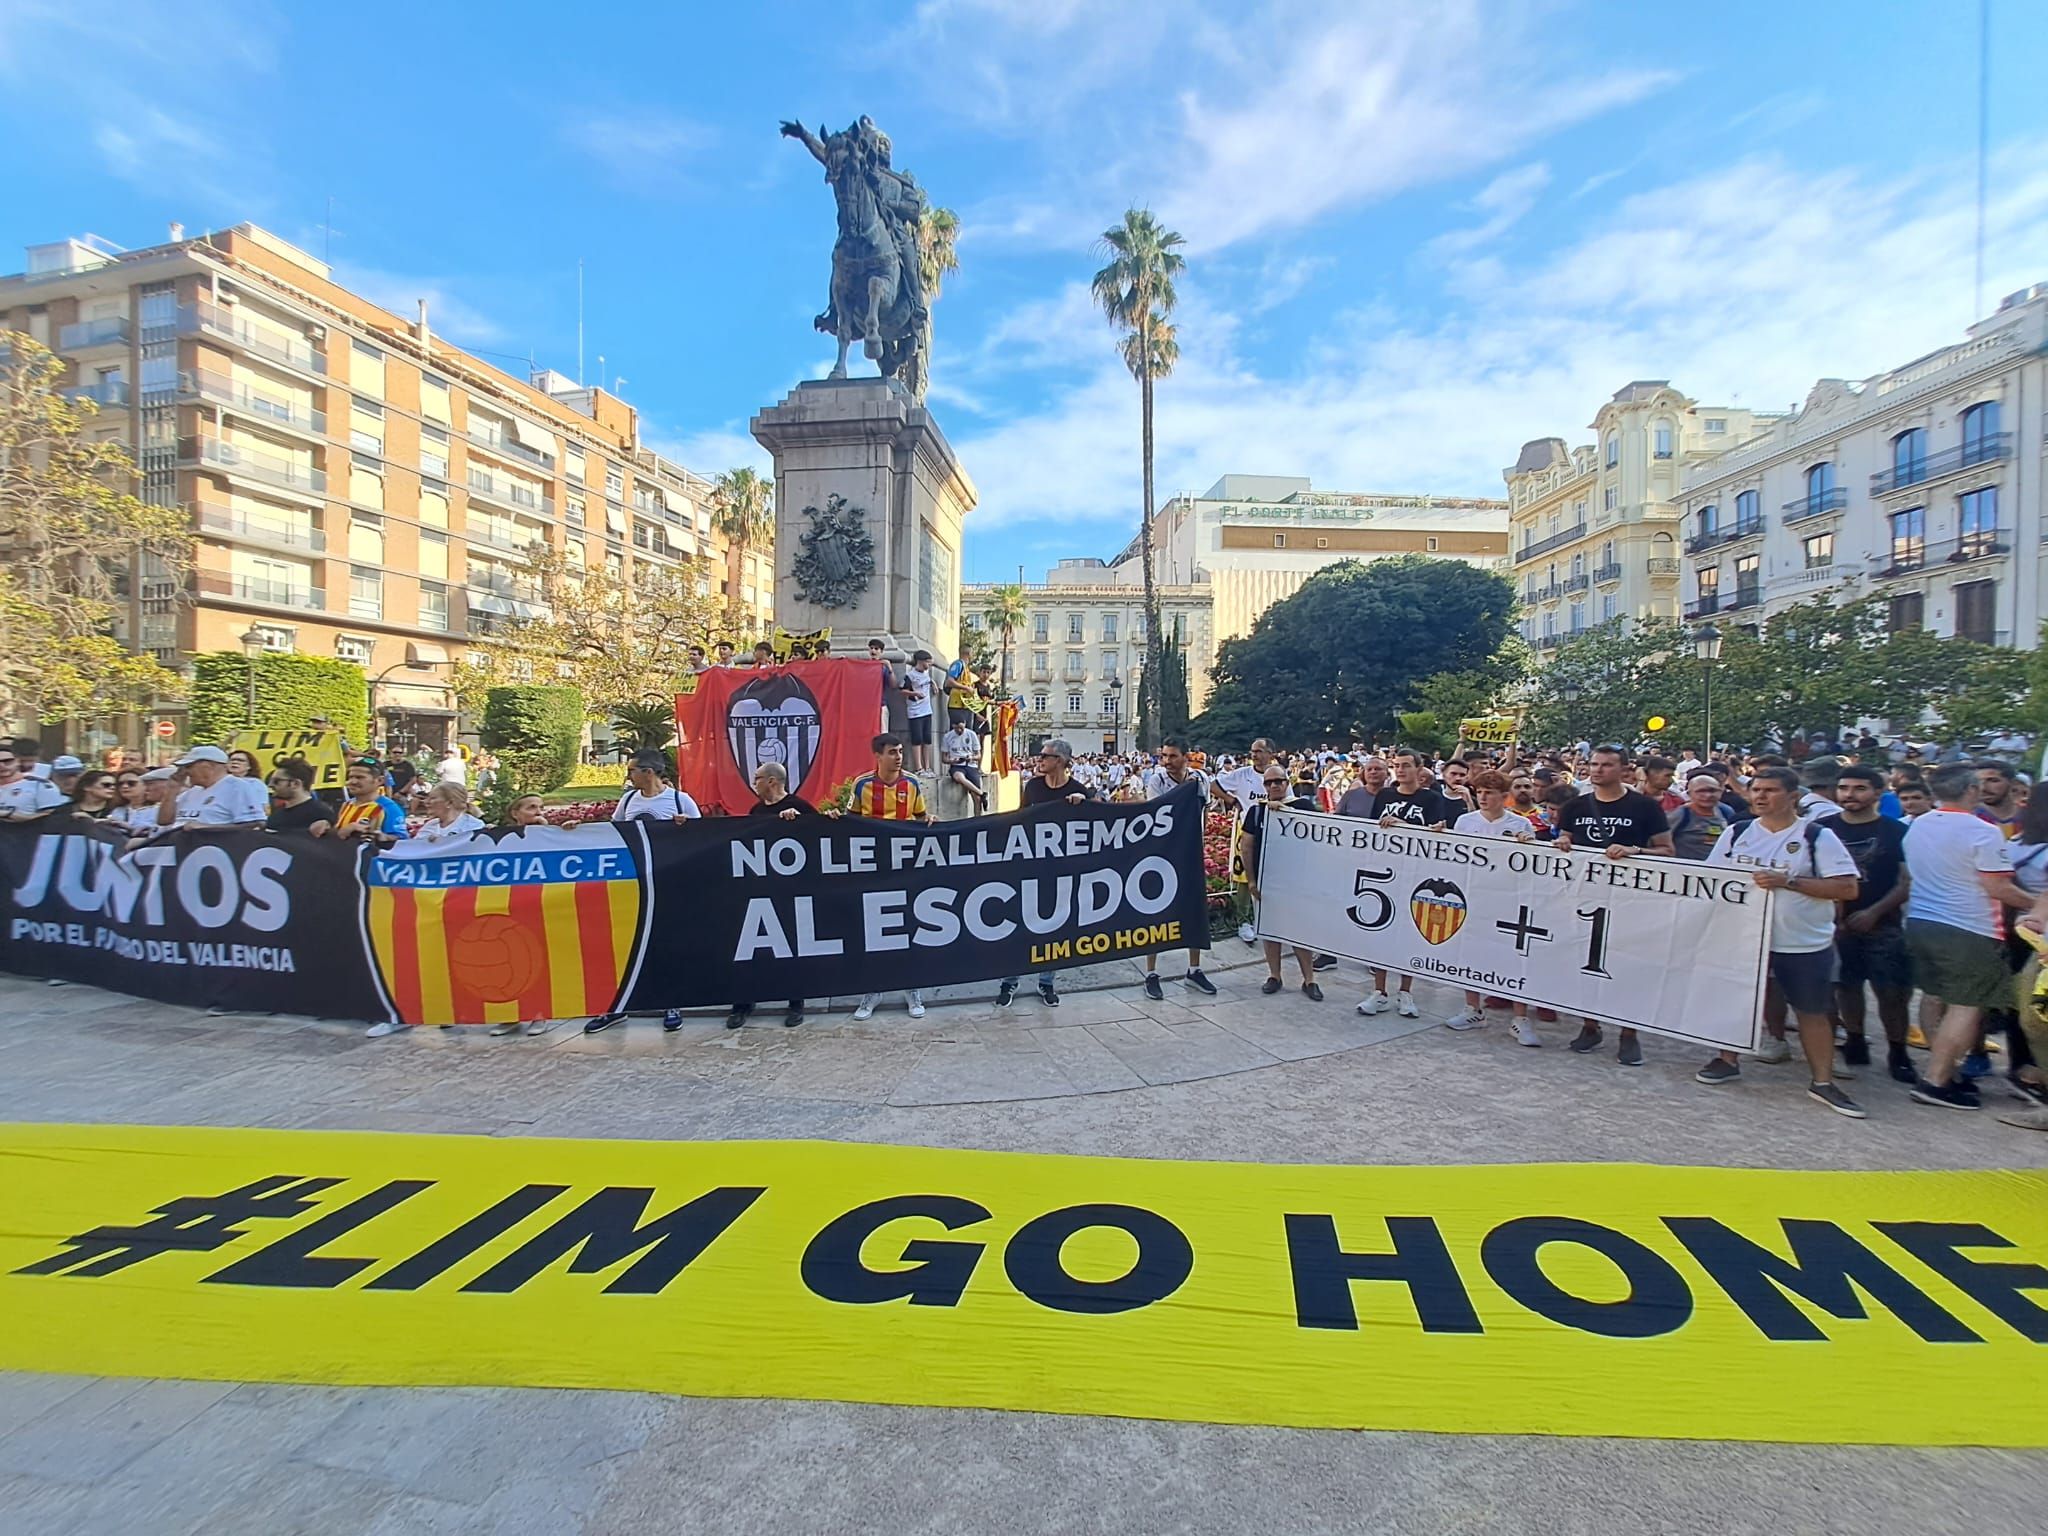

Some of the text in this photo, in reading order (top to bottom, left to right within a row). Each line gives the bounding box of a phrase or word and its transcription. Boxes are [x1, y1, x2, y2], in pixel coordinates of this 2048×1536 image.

[1222, 506, 1243, 517] EL
[1249, 507, 1305, 519] CORTE
[257, 731, 325, 750] LIM
[731, 716, 816, 727] VALENCIA C.F.
[1466, 729, 1513, 741] HOME
[1480, 721, 1498, 729] GO
[731, 804, 1175, 878] NO LE FALLAREMOS
[1277, 817, 1748, 905] YOUR BUSINESS, OUR FEELING
[13, 834, 294, 932] JUNTOS
[377, 853, 623, 886] VALENCIA C.F.
[734, 896, 844, 962] AL
[863, 855, 1179, 954] ESCUDO
[1345, 867, 1397, 932] 5
[1576, 906, 1613, 980] 1
[11, 918, 63, 943] POR
[66, 923, 91, 947] EL
[145, 940, 188, 965] DEL
[188, 942, 296, 973] VALENCIA
[1031, 920, 1182, 964] LIM GO HOME
[1410, 956, 1527, 990] @libertadvcf
[9, 1175, 2048, 1344] #LIM GO HOME
